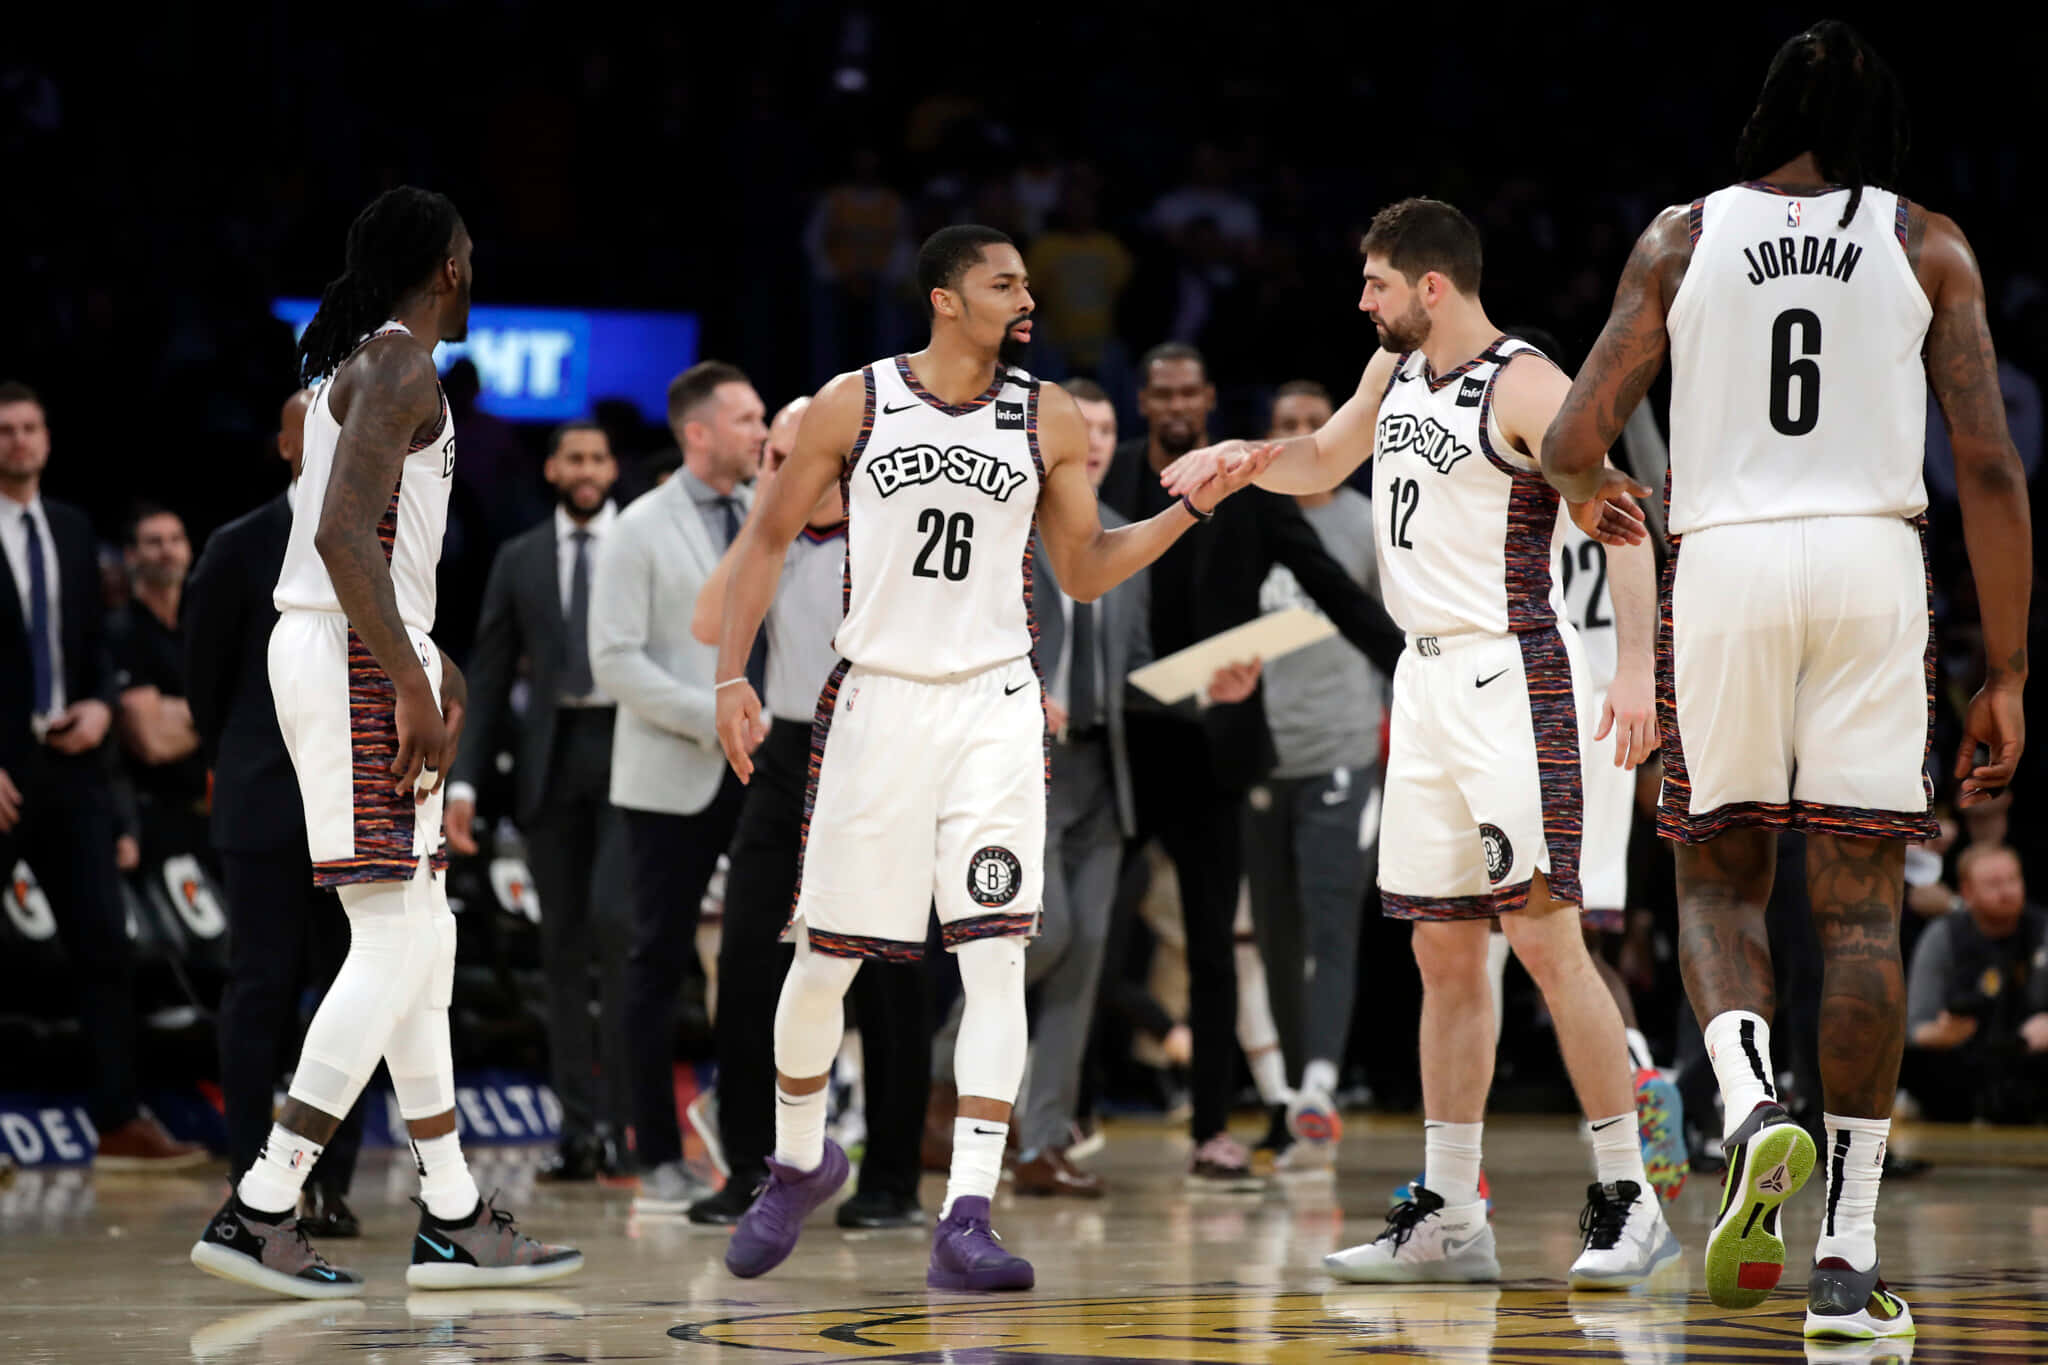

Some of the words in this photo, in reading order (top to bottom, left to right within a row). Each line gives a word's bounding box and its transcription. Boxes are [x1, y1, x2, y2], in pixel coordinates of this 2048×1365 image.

[1743, 235, 1863, 285] JORDAN
[1461, 386, 1482, 398] infor
[1769, 308, 1822, 437] 6
[997, 409, 1023, 421] infor
[1389, 477, 1420, 550] 12
[912, 508, 974, 582] 26
[988, 864, 999, 890] B
[455, 1084, 565, 1137] ELTA
